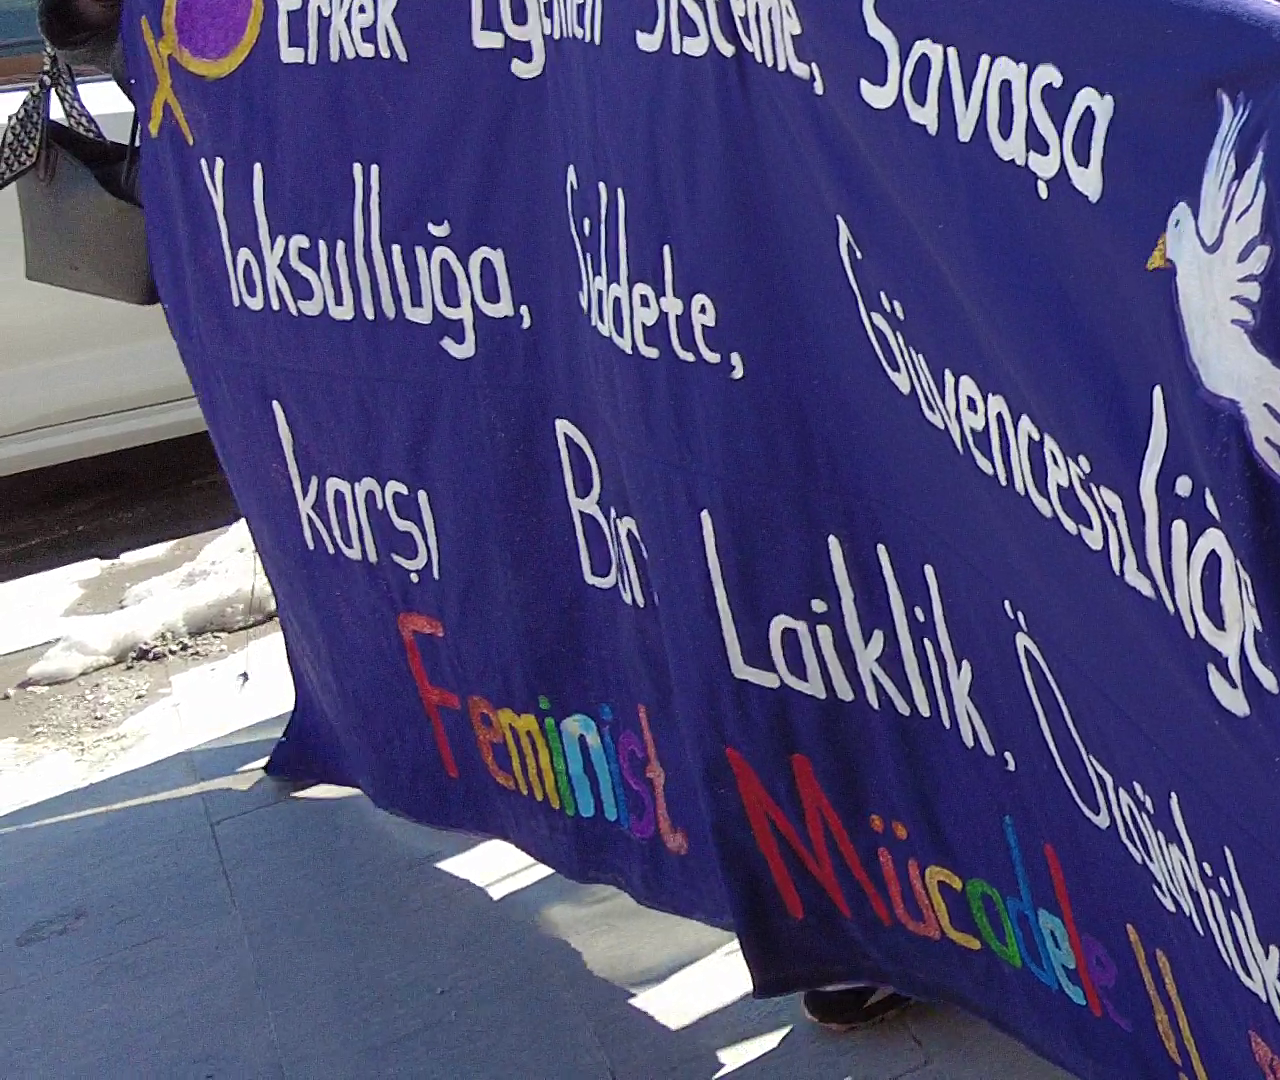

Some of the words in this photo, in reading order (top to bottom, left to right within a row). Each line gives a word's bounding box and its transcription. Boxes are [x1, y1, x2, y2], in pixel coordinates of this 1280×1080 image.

[200, 155, 532, 361] Yoksulluğa,
[271, 399, 441, 584] karşı
[398, 610, 688, 856] Feminist
